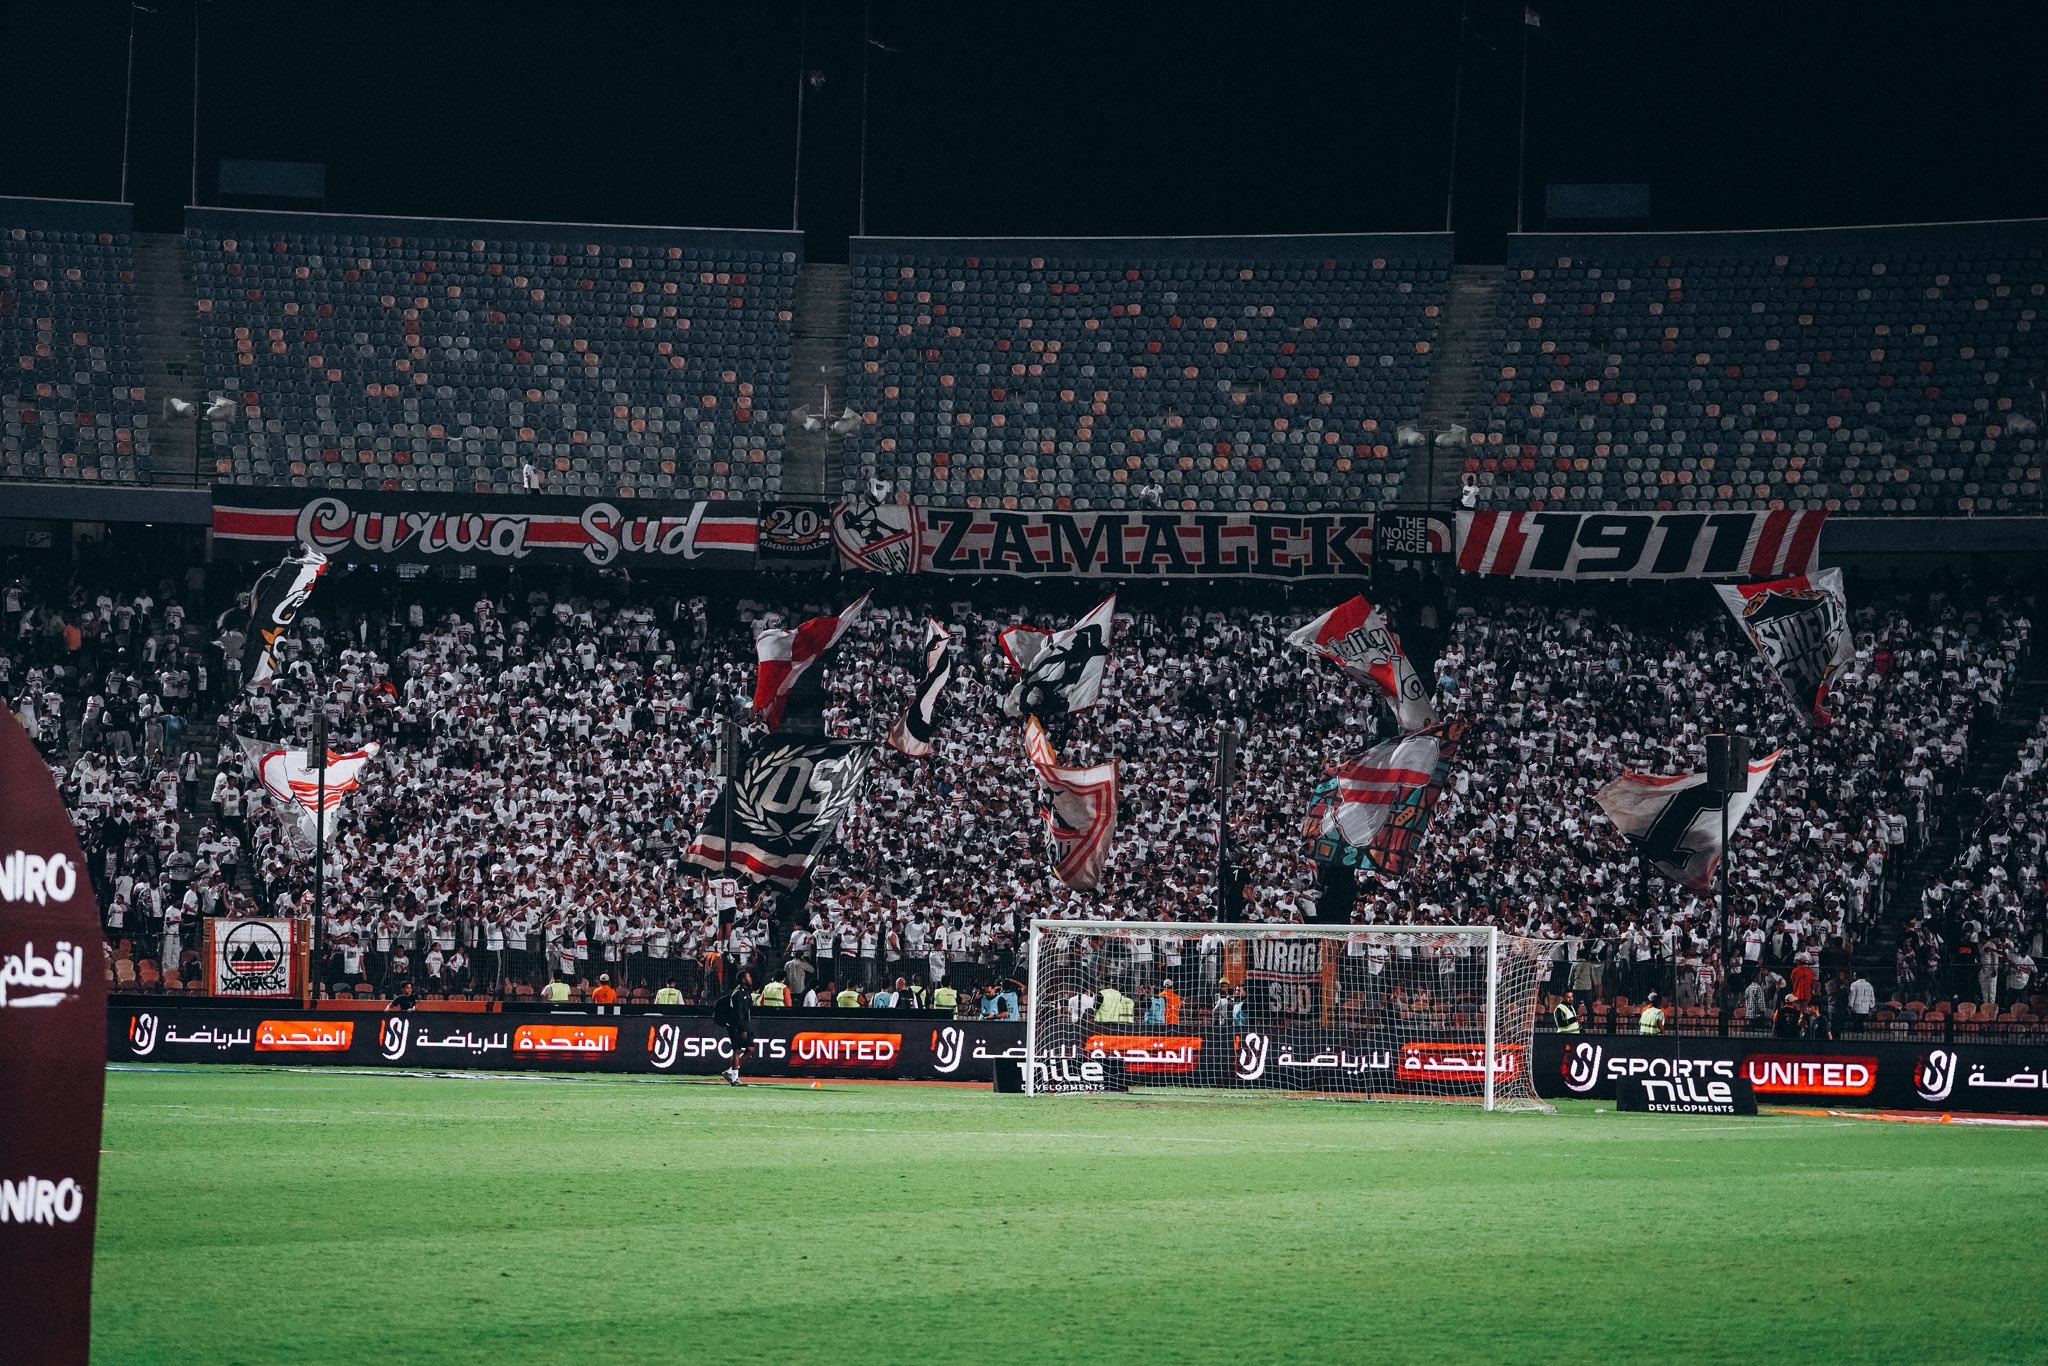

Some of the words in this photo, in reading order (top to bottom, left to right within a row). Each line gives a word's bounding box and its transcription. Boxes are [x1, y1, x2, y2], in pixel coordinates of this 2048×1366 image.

[297, 497, 531, 558] Curva
[581, 500, 708, 565] Sud
[771, 509, 818, 535] 20
[1381, 527, 1425, 540] NOISE
[1396, 516, 1425, 529] THE
[928, 511, 1369, 575] ZAMALEK
[1386, 539, 1425, 553] FACE
[1529, 513, 1757, 573] 1911
[1252, 939, 1322, 972] VIRAG
[1268, 982, 1312, 1014] SUD
[165, 1025, 250, 1050] للرياضة
[262, 1026, 346, 1046] المتحدة
[416, 1028, 508, 1055] للرياضة
[520, 1031, 609, 1051] المتحدة
[684, 1038, 786, 1059] SPOTS
[799, 1040, 894, 1061] UNITED
[1278, 1045, 1390, 1075] للرياضة
[1405, 1048, 1514, 1073] التحدة
[1607, 1057, 1734, 1080] SPORTS
[1750, 1061, 1869, 1088] UNITED
[1021, 1083, 1105, 1091] DVELOPMENTS
[1648, 1103, 1734, 1113] DEVELOPMENTS
[0, 1175, 83, 1228] NIRO
